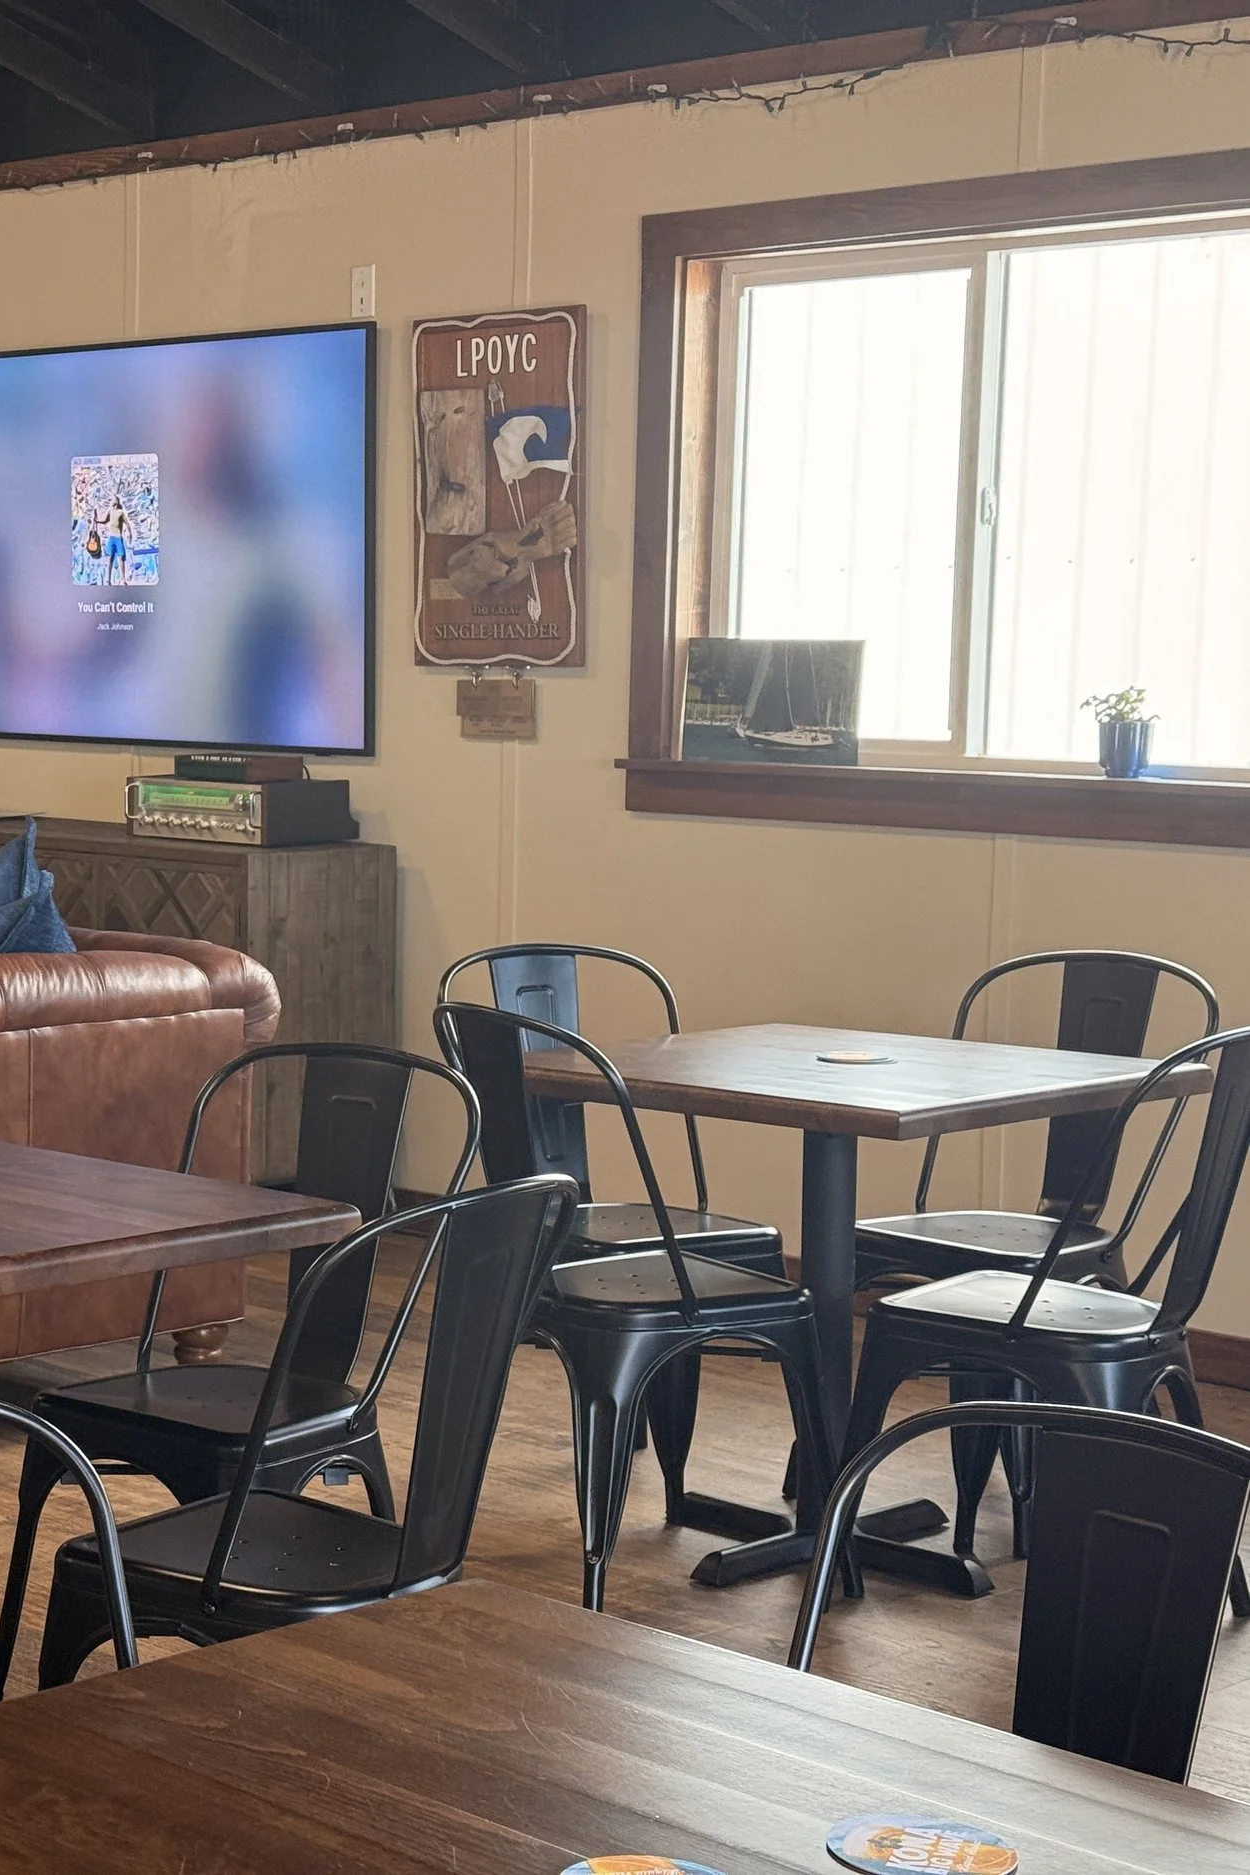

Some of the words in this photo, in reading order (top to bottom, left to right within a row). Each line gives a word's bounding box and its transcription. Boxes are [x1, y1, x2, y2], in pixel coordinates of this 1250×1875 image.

[456, 333, 538, 378] LPOYC
[77, 602, 93, 613] You
[94, 602, 115, 613] Can't
[116, 602, 146, 613] Control
[147, 602, 154, 613] It
[97, 623, 110, 631] Jack
[111, 623, 134, 631] Johnson
[434, 623, 560, 640] SINGLE-HANDER
[886, 1827, 942, 1873] KONA
[933, 1829, 967, 1857] WAVE
